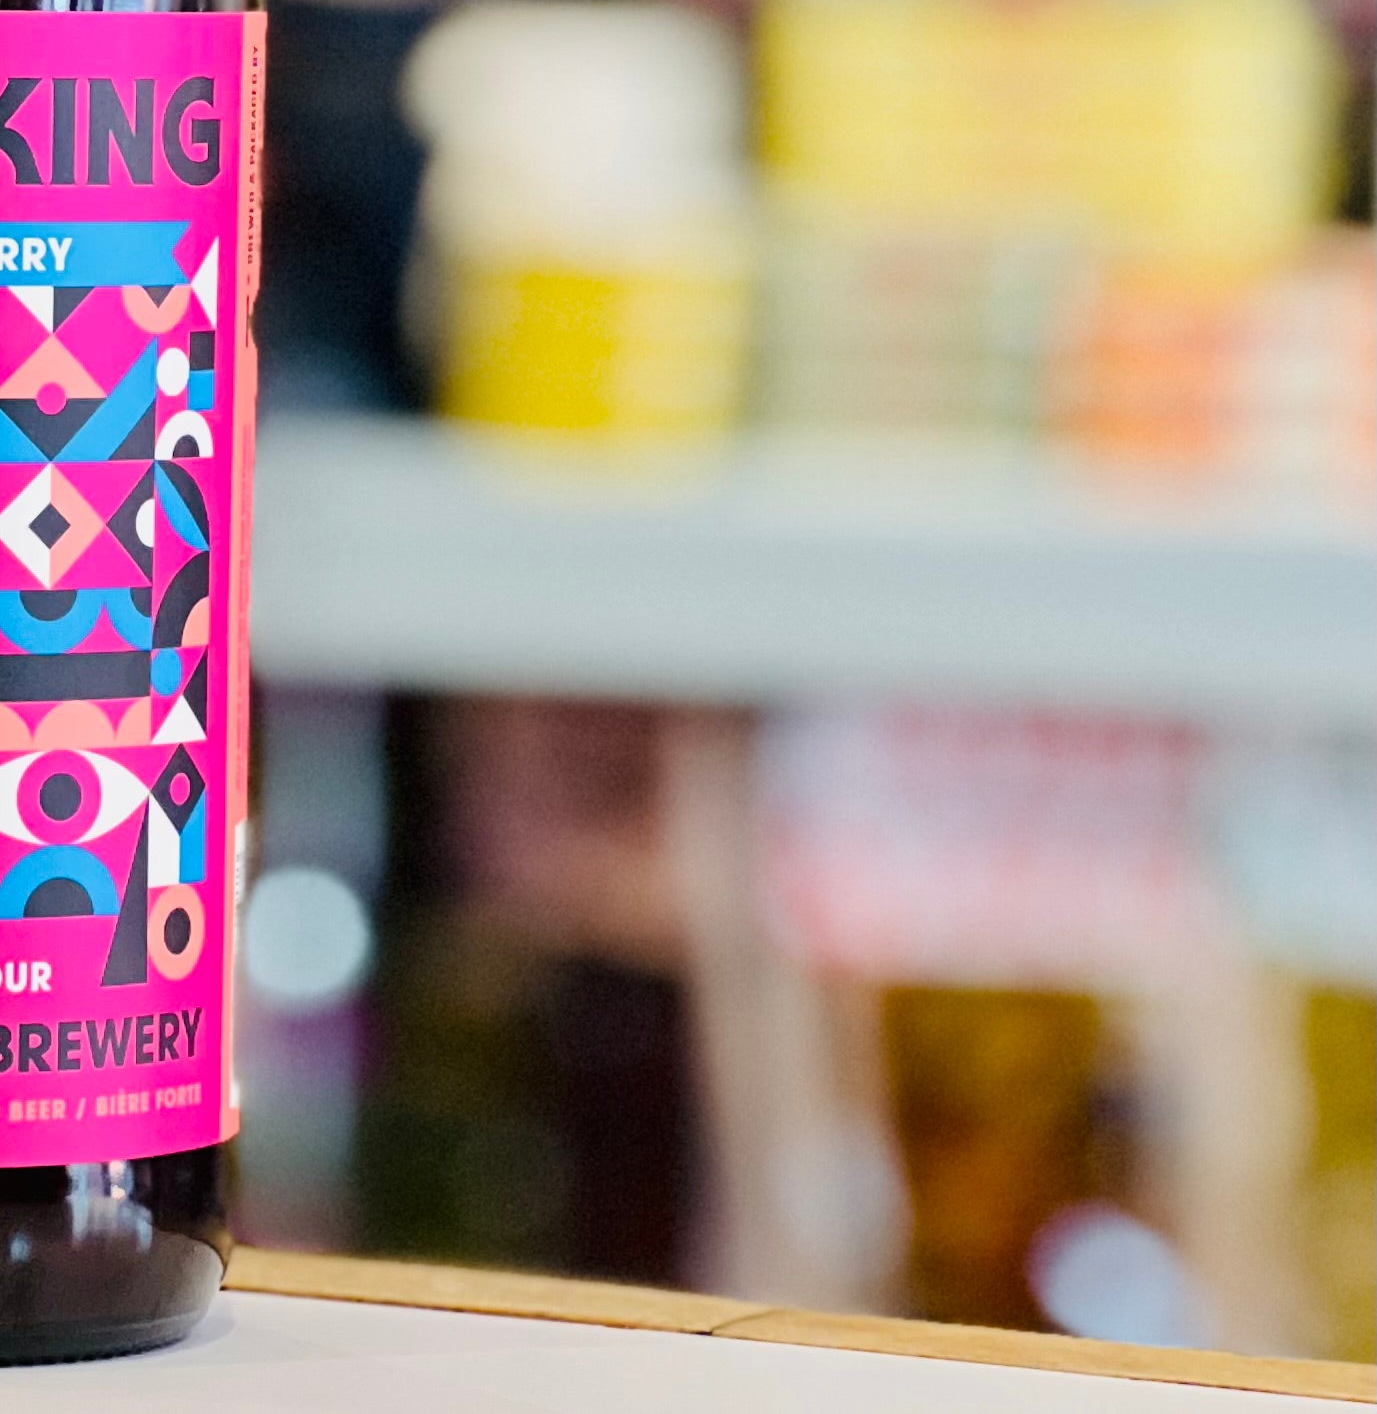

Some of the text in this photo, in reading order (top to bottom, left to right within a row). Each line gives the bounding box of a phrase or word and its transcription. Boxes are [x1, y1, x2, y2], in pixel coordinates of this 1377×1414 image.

[9, 1099, 66, 1122] BEER
[76, 1097, 87, 1121] /
[96, 1089, 150, 1117] BIÈRE
[155, 1082, 202, 1109] FORTE
